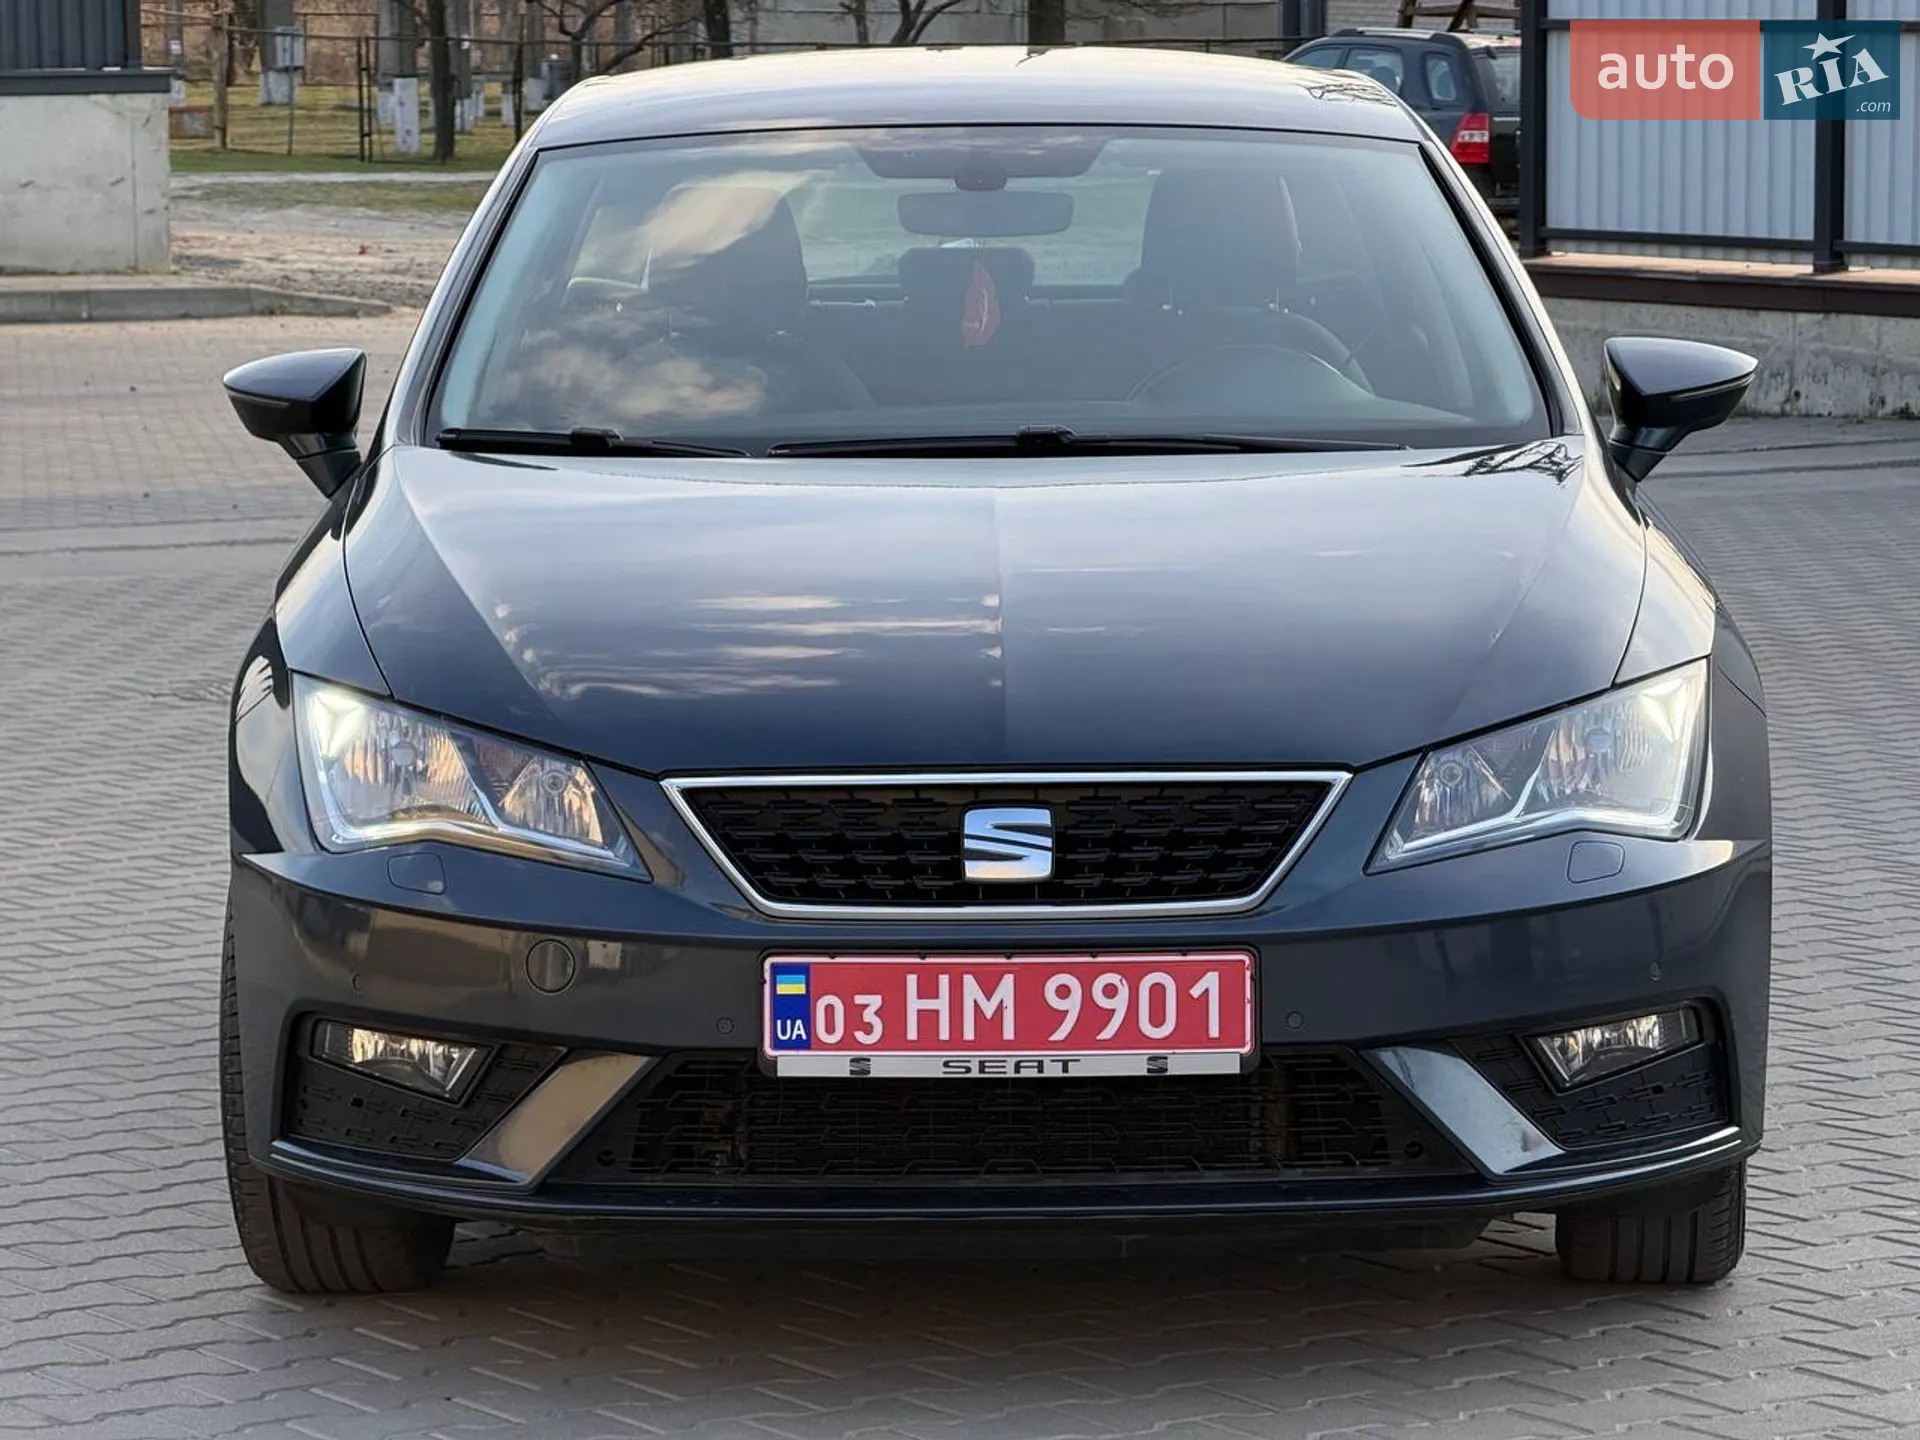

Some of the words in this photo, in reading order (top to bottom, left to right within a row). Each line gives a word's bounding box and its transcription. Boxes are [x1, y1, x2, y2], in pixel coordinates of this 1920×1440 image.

[815, 994, 884, 1046] 03
[905, 973, 1015, 1041] HM
[1043, 971, 1221, 1042] 9901
[776, 1019, 807, 1041] UA
[941, 1059, 1081, 1075] SEAT
